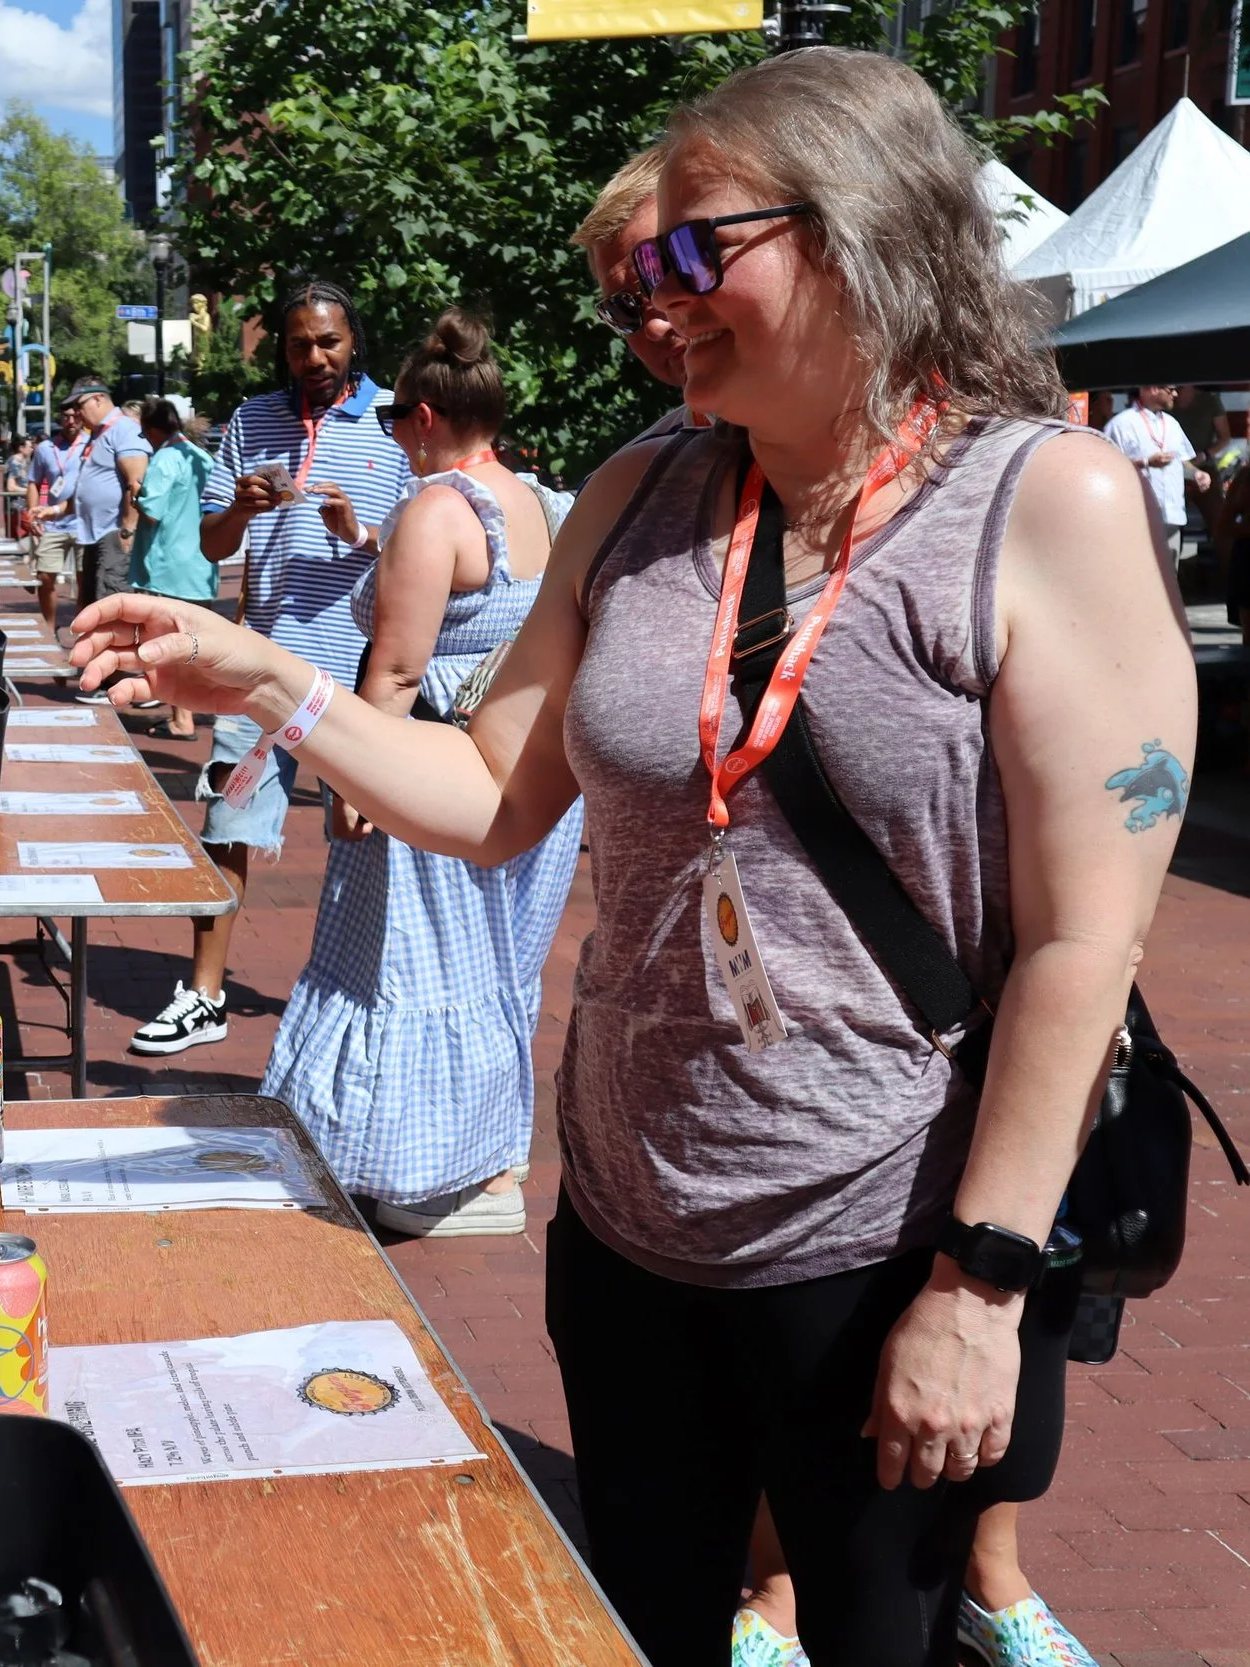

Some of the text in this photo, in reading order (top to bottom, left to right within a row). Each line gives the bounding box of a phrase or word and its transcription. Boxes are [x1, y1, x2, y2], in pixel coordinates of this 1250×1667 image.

[715, 593, 736, 657] Puttshack
[780, 615, 823, 680] Puttshack
[159, 1350, 174, 1369] cascade
[232, 1432, 247, 1443] and
[137, 1453, 155, 1468] HAZY
[201, 1446, 212, 1464] Waves
[238, 1443, 259, 1461] punch
